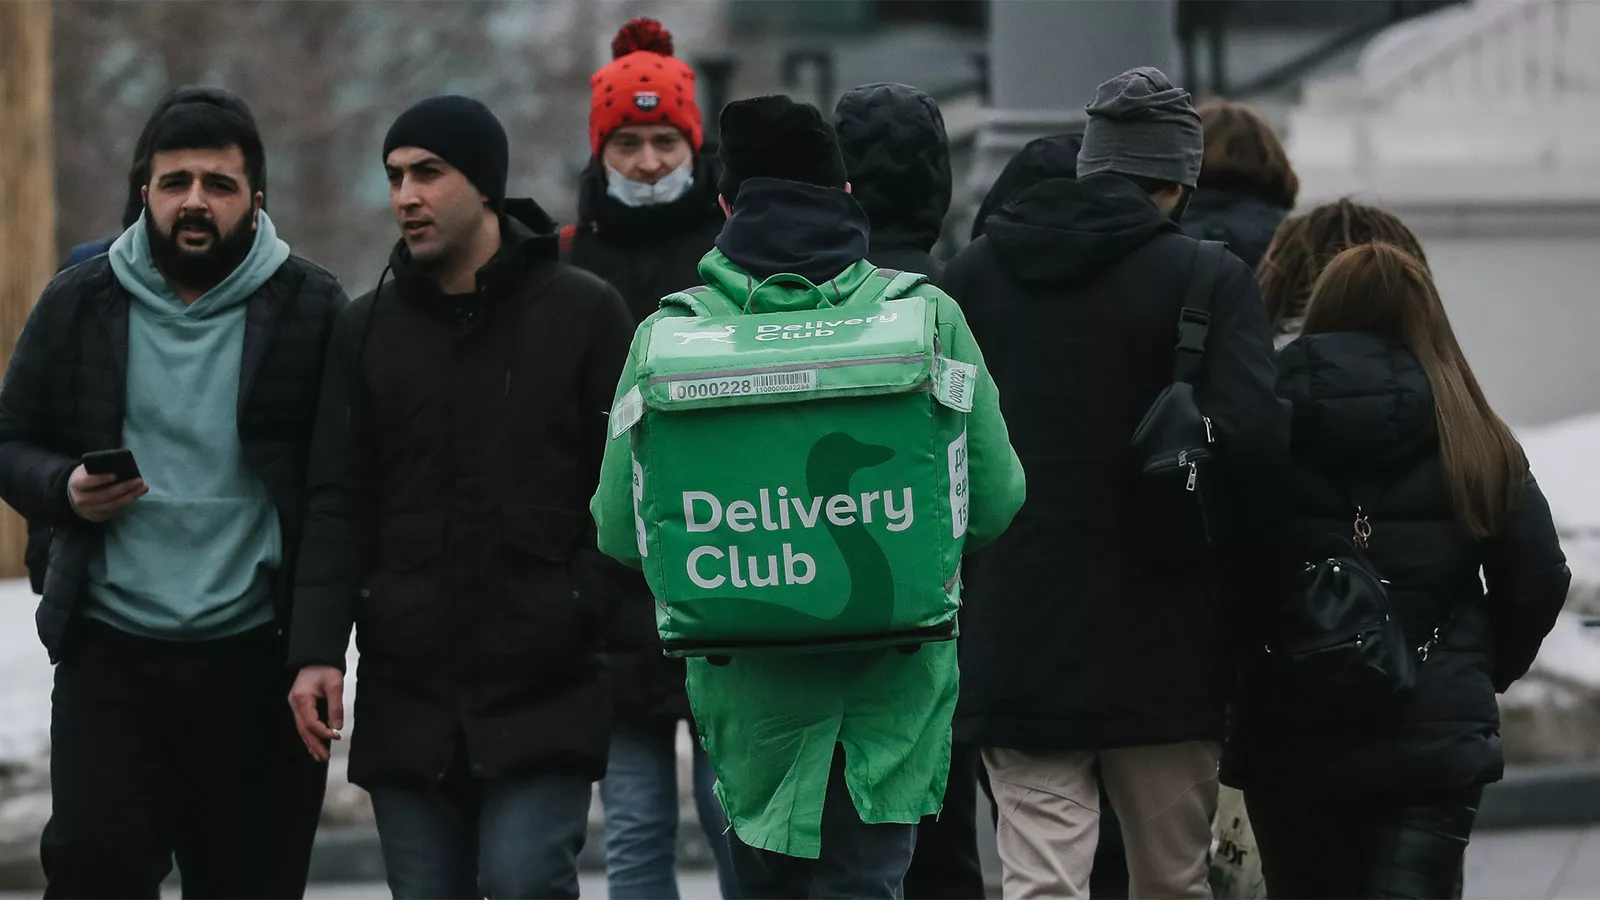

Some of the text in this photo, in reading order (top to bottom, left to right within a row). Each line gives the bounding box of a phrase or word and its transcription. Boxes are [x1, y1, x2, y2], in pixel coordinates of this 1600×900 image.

[757, 312, 898, 333] Delivery
[755, 329, 835, 341] Club
[677, 380, 752, 399] 0000228
[682, 486, 914, 533] Delivery
[686, 543, 817, 589] Club
